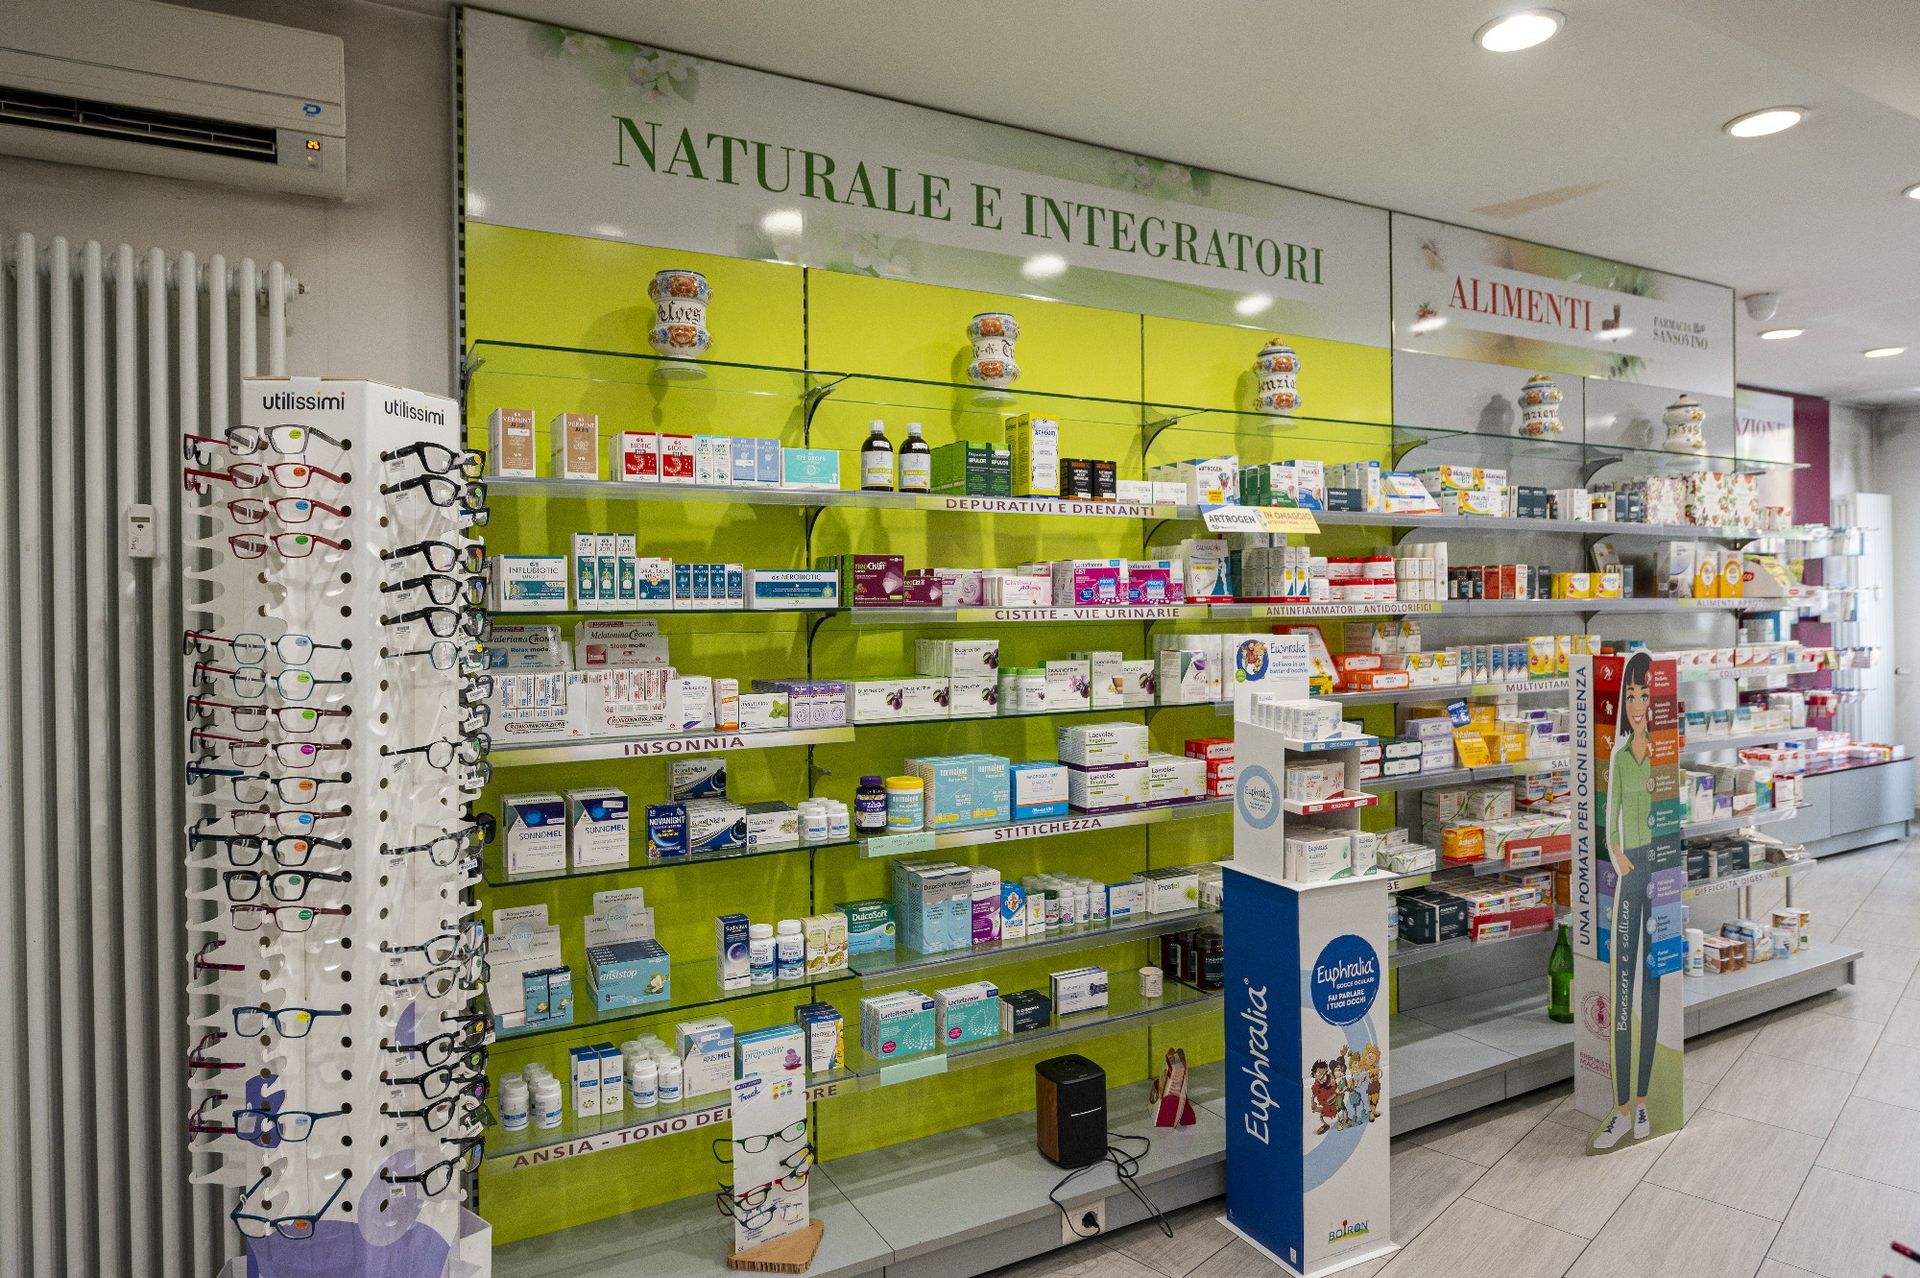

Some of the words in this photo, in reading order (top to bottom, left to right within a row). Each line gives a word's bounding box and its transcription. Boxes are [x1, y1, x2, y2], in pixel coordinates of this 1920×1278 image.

[612, 115, 951, 222] NATURALE
[970, 183, 1002, 231] E
[1021, 193, 1325, 286] INTEGRATORI
[1448, 275, 1592, 332] ALIMENTI
[1653, 316, 1692, 333] FARMACIA
[1653, 331, 1708, 351] SANSOVINO
[263, 392, 345, 410] utilissimi
[384, 400, 445, 426] utilissimi
[945, 498, 1052, 513] DEPURATIVI
[1059, 503, 1067, 514] E
[1073, 504, 1155, 516] DRENANTI
[1208, 514, 1257, 524] ARTROGEN
[1275, 512, 1312, 521] OMAGGIO
[781, 573, 822, 581] AEROBIOTIC
[995, 609, 1058, 620] CISTITE
[1074, 609, 1100, 619] VIE
[1105, 608, 1180, 619] URINARIE
[1266, 606, 1356, 616] ANTINFIAMMATORI
[1363, 603, 1432, 614] ANTIDOLORIFICI
[1506, 680, 1569, 693] MULTIVITAM
[1575, 665, 1588, 748] ESIGENZA
[624, 736, 745, 756] INSONNIA
[1576, 752, 1588, 798] OGNI
[650, 814, 687, 826] NOVANIGHT
[1577, 800, 1589, 831] PER
[519, 830, 562, 841] SONNOMEL
[584, 824, 626, 834] SONNOMEL
[994, 818, 1102, 840] STITICHEZZA
[1578, 836, 1589, 903] POMATA
[852, 910, 888, 921] DulcoSoft
[1579, 910, 1591, 946] UNA
[1622, 900, 1631, 950] sollievo
[1317, 957, 1375, 989] Euphralia
[1336, 981, 1354, 989] GOCCE
[1354, 977, 1375, 986] OCULARI
[1328, 994, 1338, 1002] FAI
[1338, 989, 1365, 1000] PARLARE
[1330, 1001, 1346, 1010] TUOI
[1346, 996, 1366, 1006] OCCHI
[1616, 970, 1630, 1032] Benessere
[880, 1008, 914, 1019] Lactoflorene
[738, 1087, 761, 1102] Track
[513, 1140, 594, 1169] ANSIA
[618, 1118, 687, 1144] TONO
[1328, 1219, 1369, 1242] BOIRON
